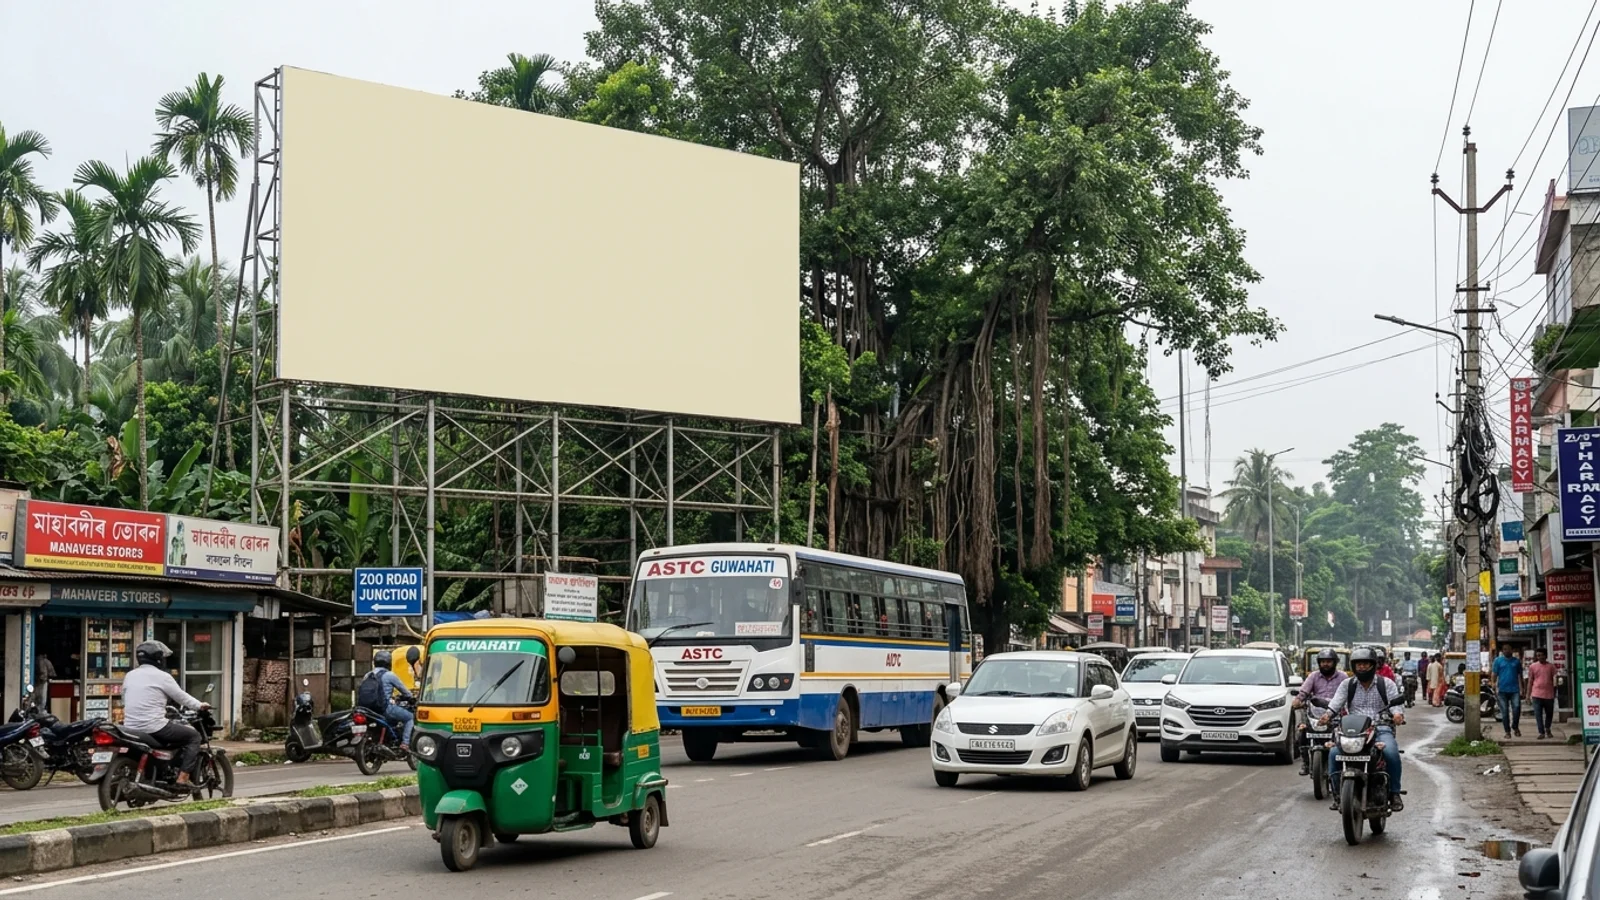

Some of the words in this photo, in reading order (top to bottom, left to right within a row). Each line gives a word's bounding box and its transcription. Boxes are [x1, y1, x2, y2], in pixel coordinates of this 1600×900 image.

[1514, 392, 1530, 480] PHARMACY
[107, 545, 143, 559] STORES
[647, 560, 705, 577] ASTC
[711, 560, 775, 573] GUWAHATI
[359, 573, 384, 585] ZOO
[386, 573, 417, 585] ROAD
[60, 588, 118, 602] MAHAVEER
[121, 590, 161, 604] STORES
[359, 588, 417, 601] JUNCTION
[681, 648, 723, 660] ASTC
